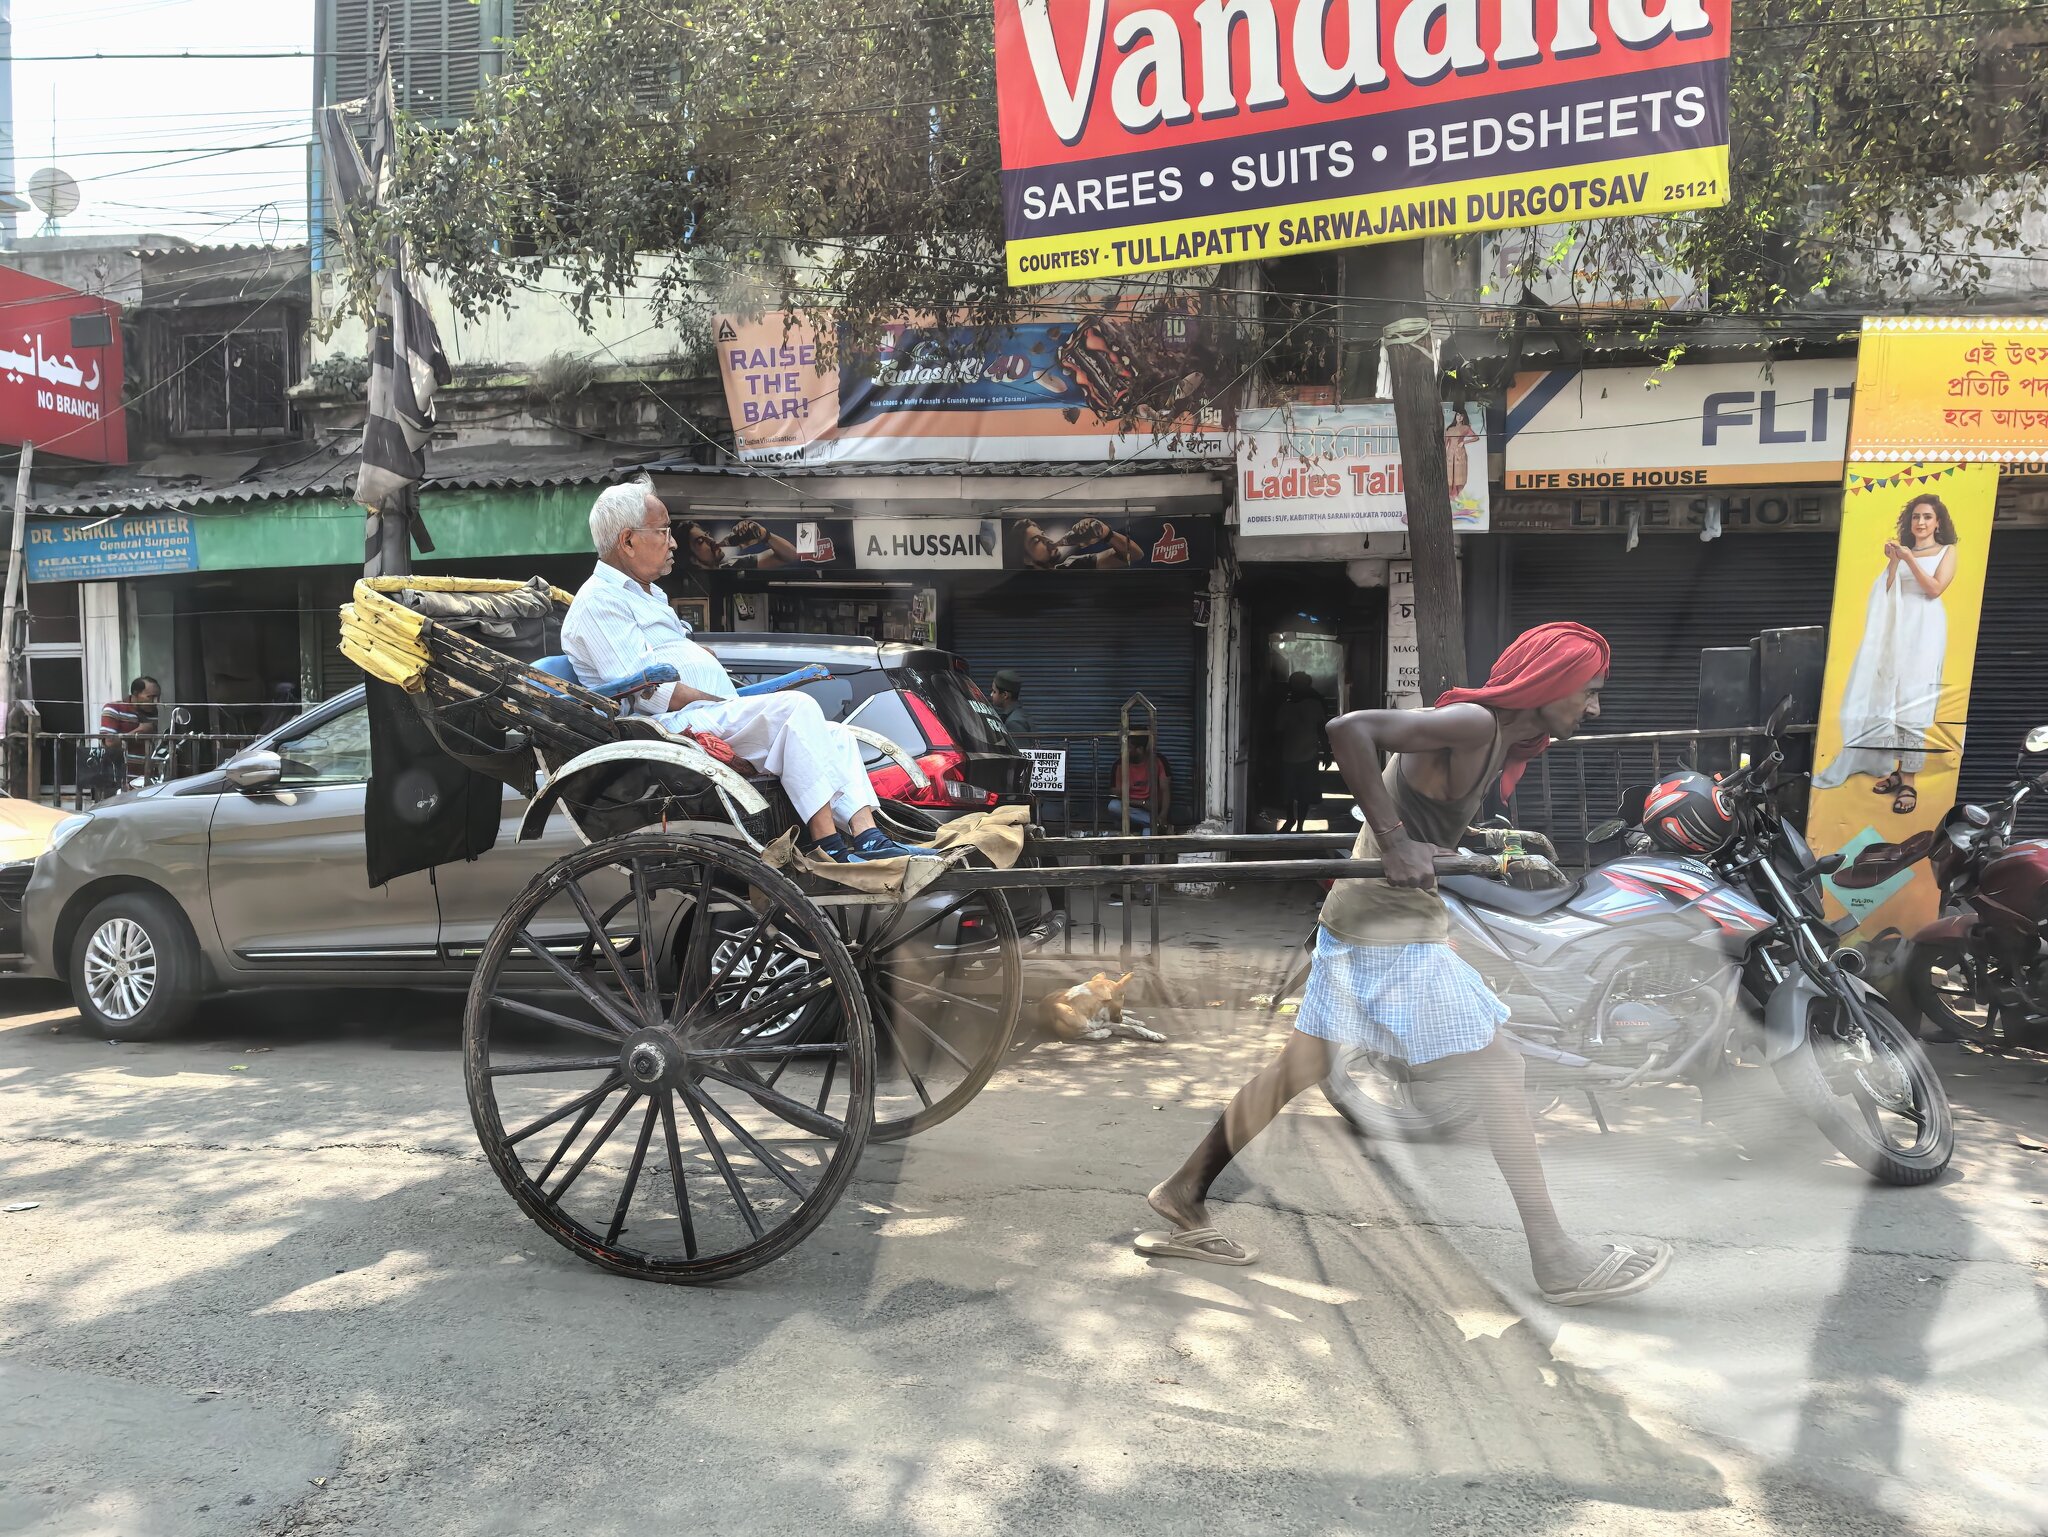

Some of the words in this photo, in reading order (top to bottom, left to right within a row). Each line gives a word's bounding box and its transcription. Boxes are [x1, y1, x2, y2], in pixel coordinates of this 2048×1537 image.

[1022, 166, 1184, 221] SAREES
[1230, 140, 1356, 193] SUITS
[1407, 85, 1707, 168] BEDSHEETS
[1018, 246, 1101, 274] COURTESY
[1111, 221, 1271, 268] TULLAPATTY
[1277, 197, 1457, 247] SARWAJANIN
[1466, 171, 1650, 224] DURGOTSAV
[1663, 179, 1717, 201] 25121
[729, 344, 818, 371] RAISE
[1964, 339, 1998, 366] এই
[744, 371, 802, 395] THE
[1948, 369, 2011, 397] প্রতিটি
[37, 389, 54, 410] NO
[56, 393, 100, 421] BRANCH
[743, 397, 809, 423] BAR!
[1942, 408, 1983, 428] হবে
[1245, 467, 1342, 500] Ladies
[1515, 473, 1560, 489] LIFE
[1566, 471, 1626, 488] SHOE
[1632, 469, 1708, 487] HOUSE
[1350, 511, 1379, 519] KOLKATA
[1380, 510, 1403, 518] 700023
[30, 528, 58, 545] DR.
[123, 516, 190, 538] AKHTER
[99, 539, 141, 551] General
[144, 535, 190, 549] Surgeon
[866, 534, 888, 556] A.
[1155, 543, 1186, 556] Thums
[38, 554, 102, 567] HEALTH
[107, 547, 188, 562] PAVILION
[1034, 752, 1062, 760] WEIGHT
[1681, 863, 1715, 881] HONDA
